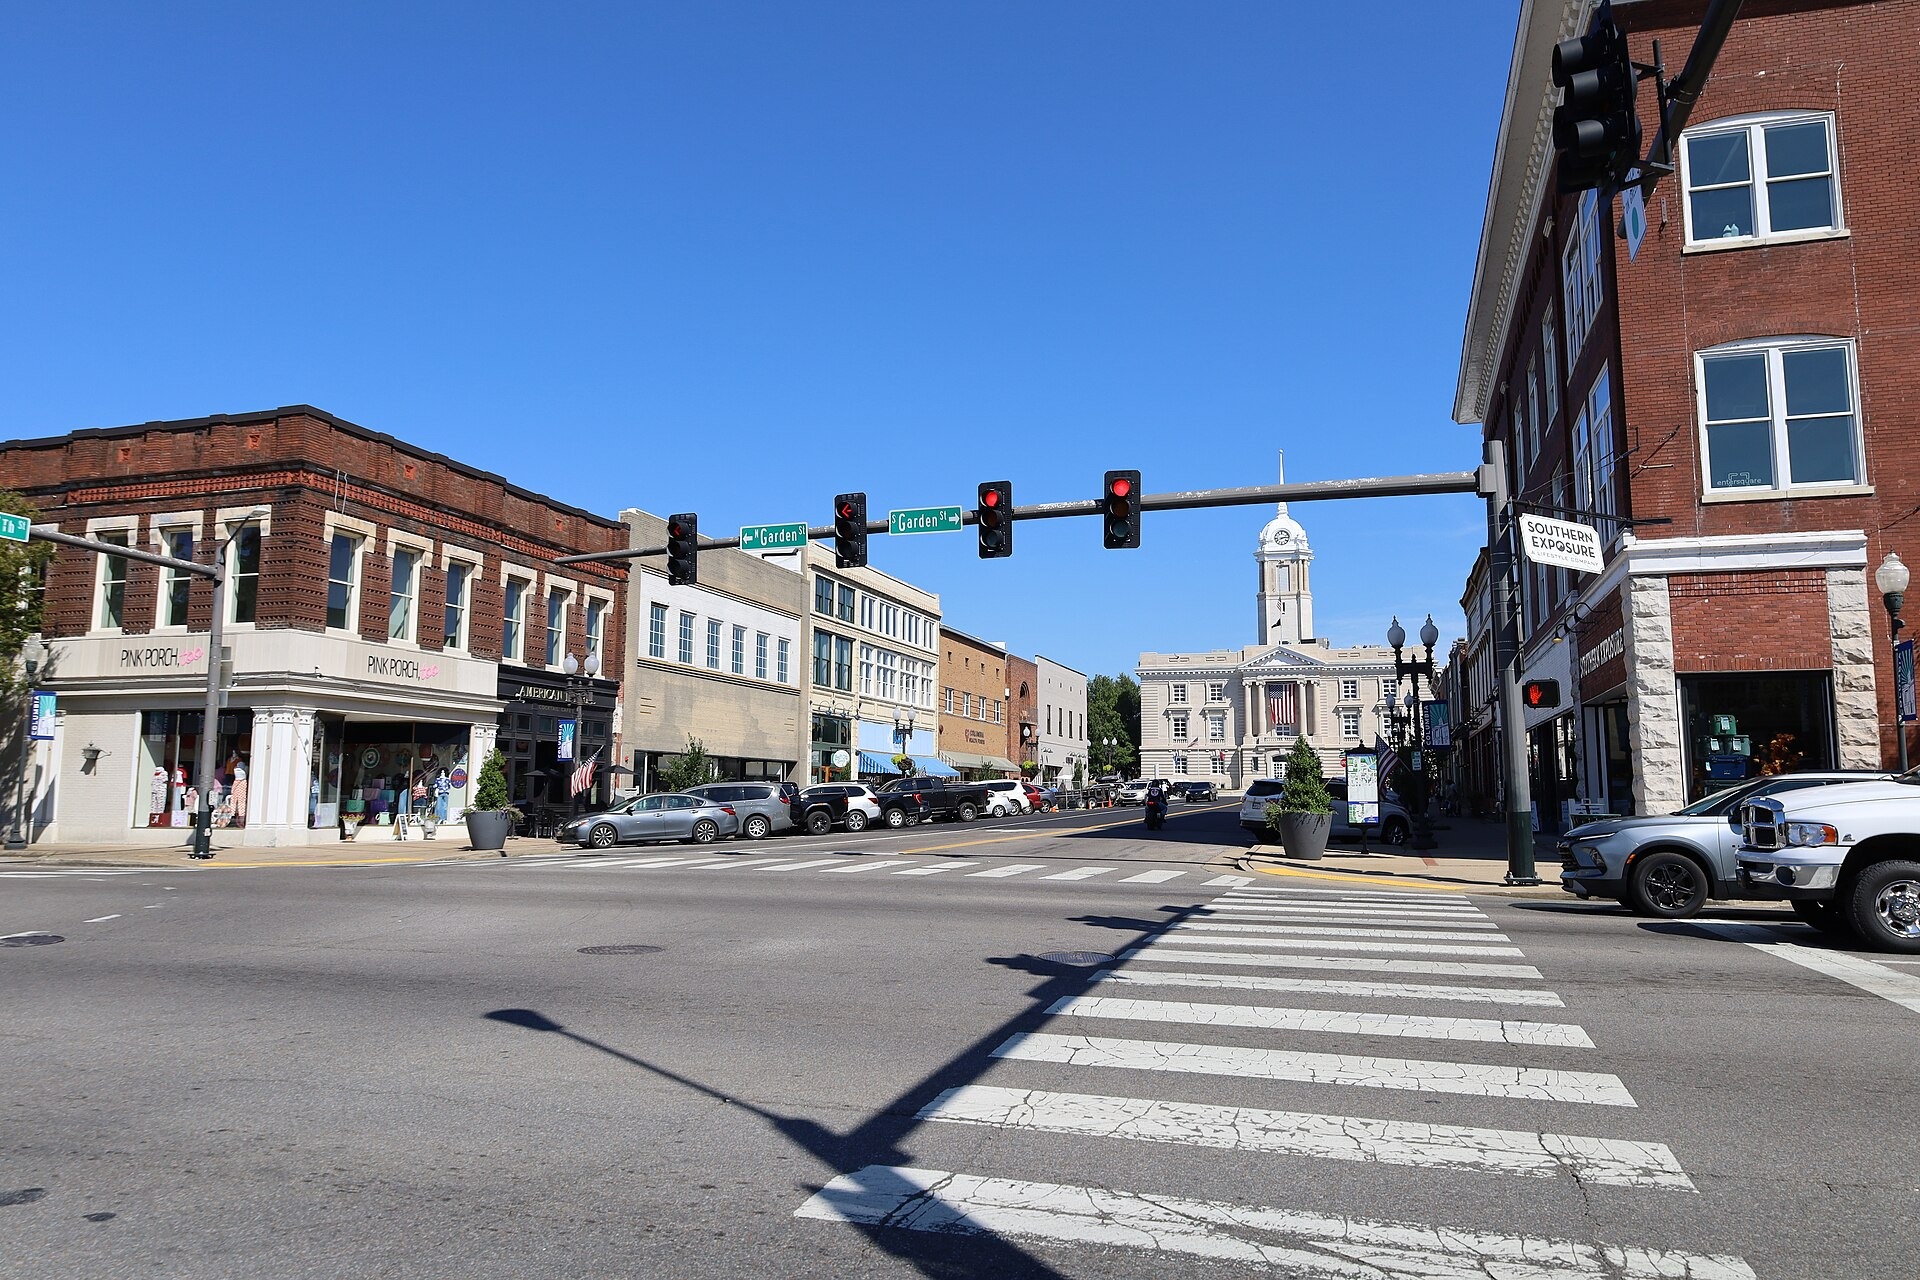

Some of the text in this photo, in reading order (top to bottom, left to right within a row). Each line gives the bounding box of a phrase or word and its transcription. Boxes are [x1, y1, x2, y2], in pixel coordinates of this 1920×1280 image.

[1717, 478, 1762, 486] entersquare
[891, 510, 947, 532] S Garden St
[1527, 521, 1594, 543] SOUTHERN
[754, 525, 806, 546] N Garden St
[1531, 535, 1596, 558] EXPOSURE
[1537, 551, 1569, 562] LIFESTYLE
[1570, 557, 1599, 567] COMPANY
[120, 649, 143, 667] PINK
[367, 655, 389, 675] PINK
[420, 664, 440, 681] too
[519, 685, 563, 701] AMERICAN
[31, 695, 40, 736] COLUMBIA
[1423, 704, 1432, 746] COLUMBIA
